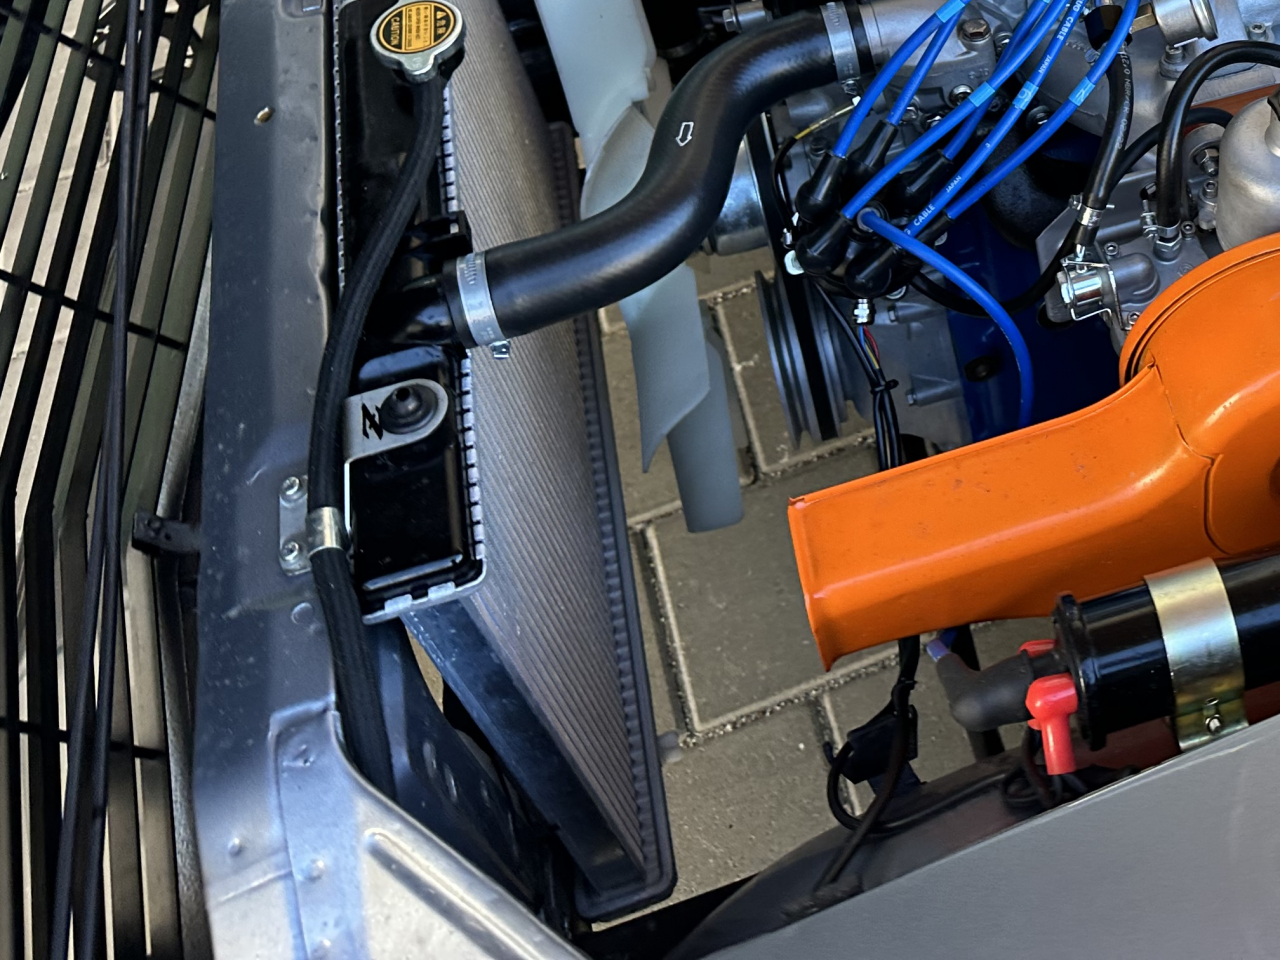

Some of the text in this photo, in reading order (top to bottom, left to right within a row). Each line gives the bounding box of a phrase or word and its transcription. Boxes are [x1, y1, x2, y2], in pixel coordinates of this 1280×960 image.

[391, 17, 399, 45] CAUTION
[1057, 17, 1073, 41] CABLE
[1038, 55, 1052, 74] JAPAN
[914, 176, 962, 226] CABLE JAPAN
